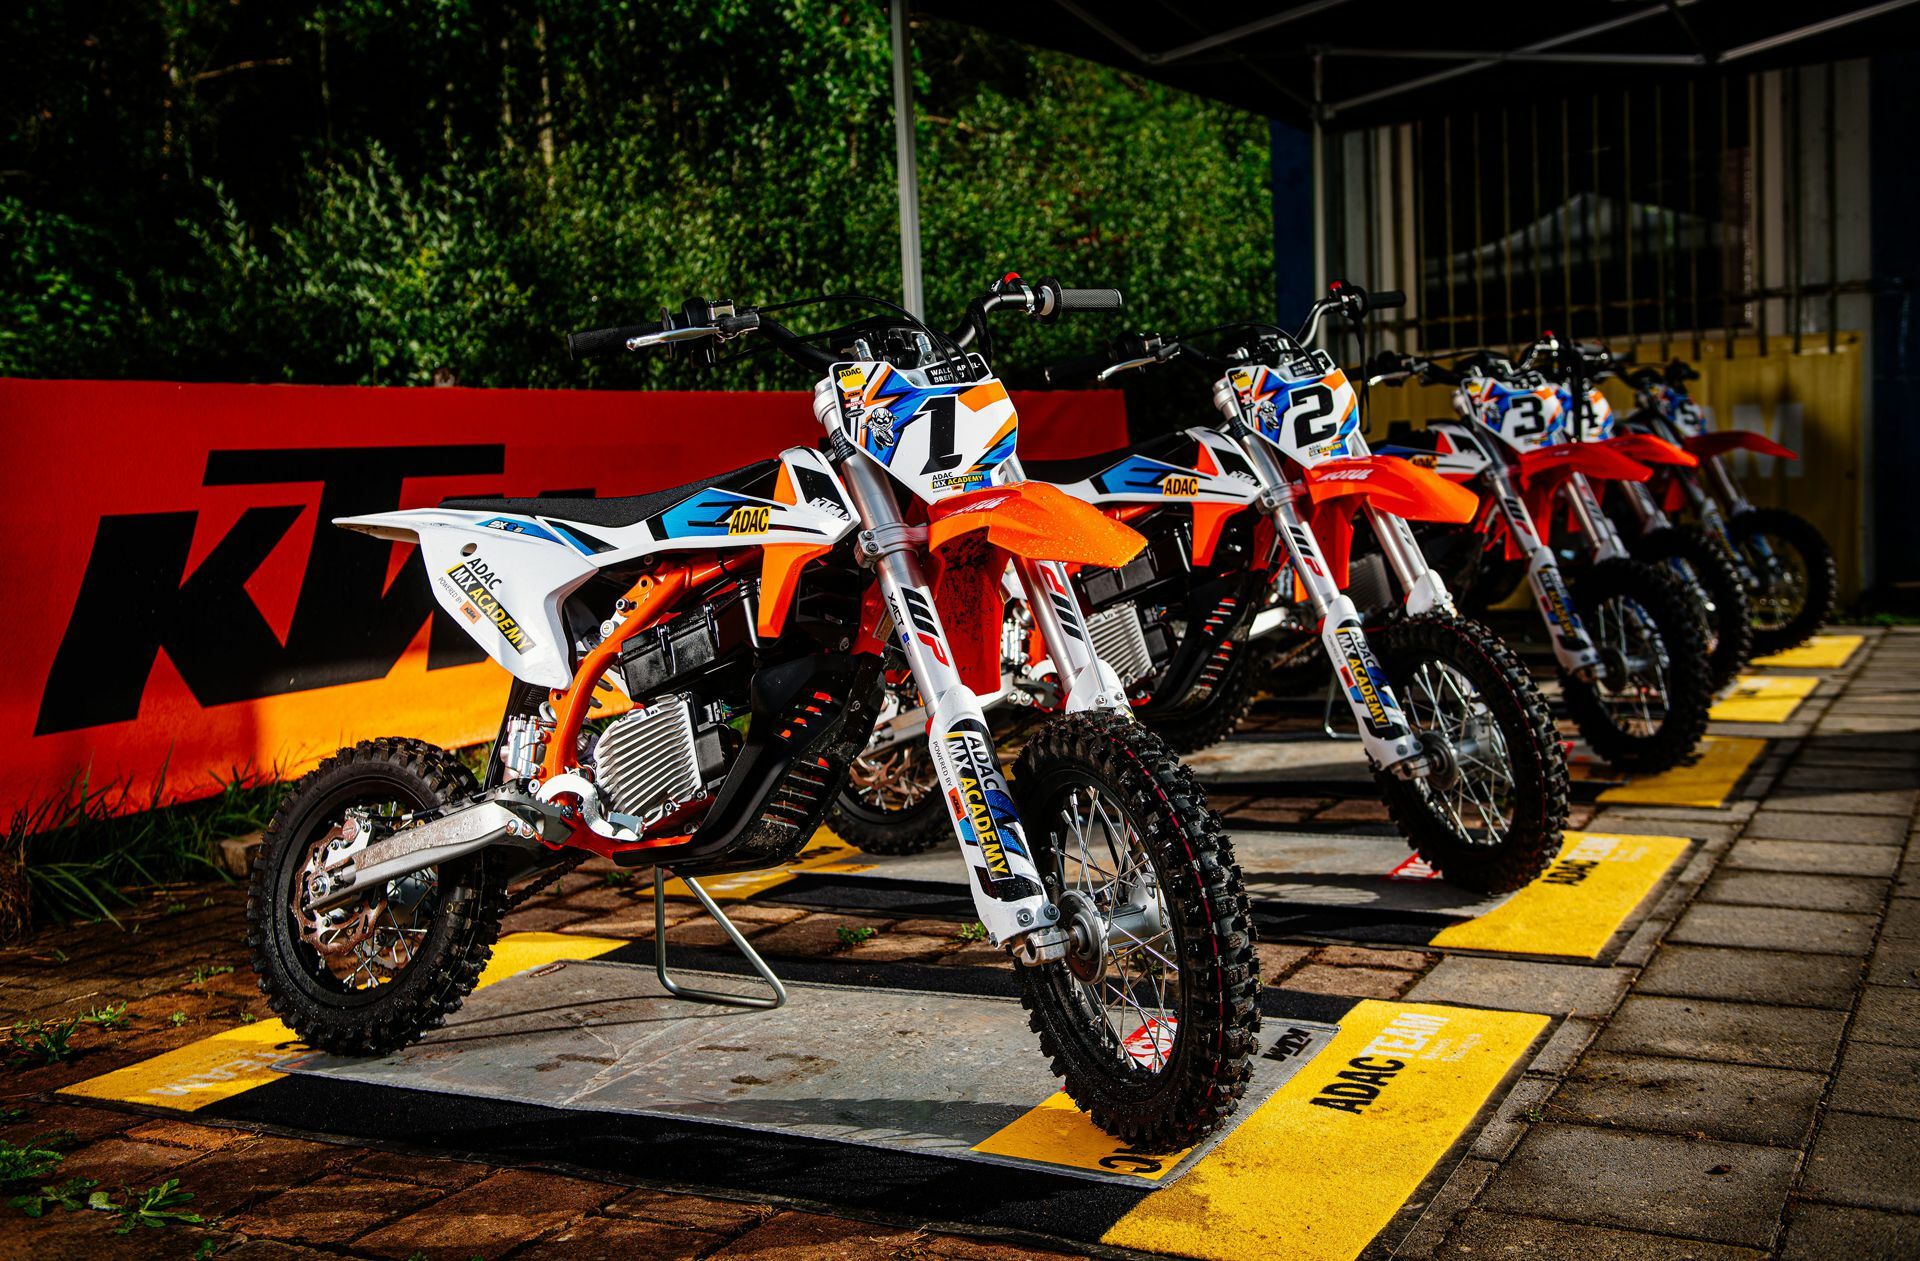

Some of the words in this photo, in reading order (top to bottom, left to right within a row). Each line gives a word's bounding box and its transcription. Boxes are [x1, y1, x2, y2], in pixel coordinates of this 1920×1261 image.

[840, 367, 862, 378] ADAC
[1289, 385, 1338, 449] 2
[1511, 396, 1546, 438] 3
[1680, 400, 1699, 425] 5
[919, 396, 963, 476] 1
[932, 471, 953, 481] ADAC
[933, 479, 947, 489] MX
[947, 475, 983, 486] ACADEMY
[1164, 478, 1197, 495] ADAC
[729, 508, 769, 534] ADAC
[438, 576, 459, 599] POWERED
[455, 595, 463, 604] BY
[466, 557, 503, 590] ADAC
[451, 567, 477, 591] MX
[468, 587, 532, 650] ACADEMY
[887, 592, 905, 626] XACT
[901, 587, 950, 668] WP
[1350, 630, 1376, 668] ADAC
[1336, 632, 1357, 658] MX
[1348, 657, 1388, 725] ACADEMY
[932, 740, 948, 779] POWERED
[943, 777, 953, 787] BY
[967, 735, 999, 790] ADAC
[948, 740, 972, 773] MX
[960, 776, 1009, 874] ACADEMY
[1262, 1027, 1312, 1062] KTM
[1309, 1056, 1406, 1115] ADAC
[1359, 1012, 1450, 1059] TEAM
